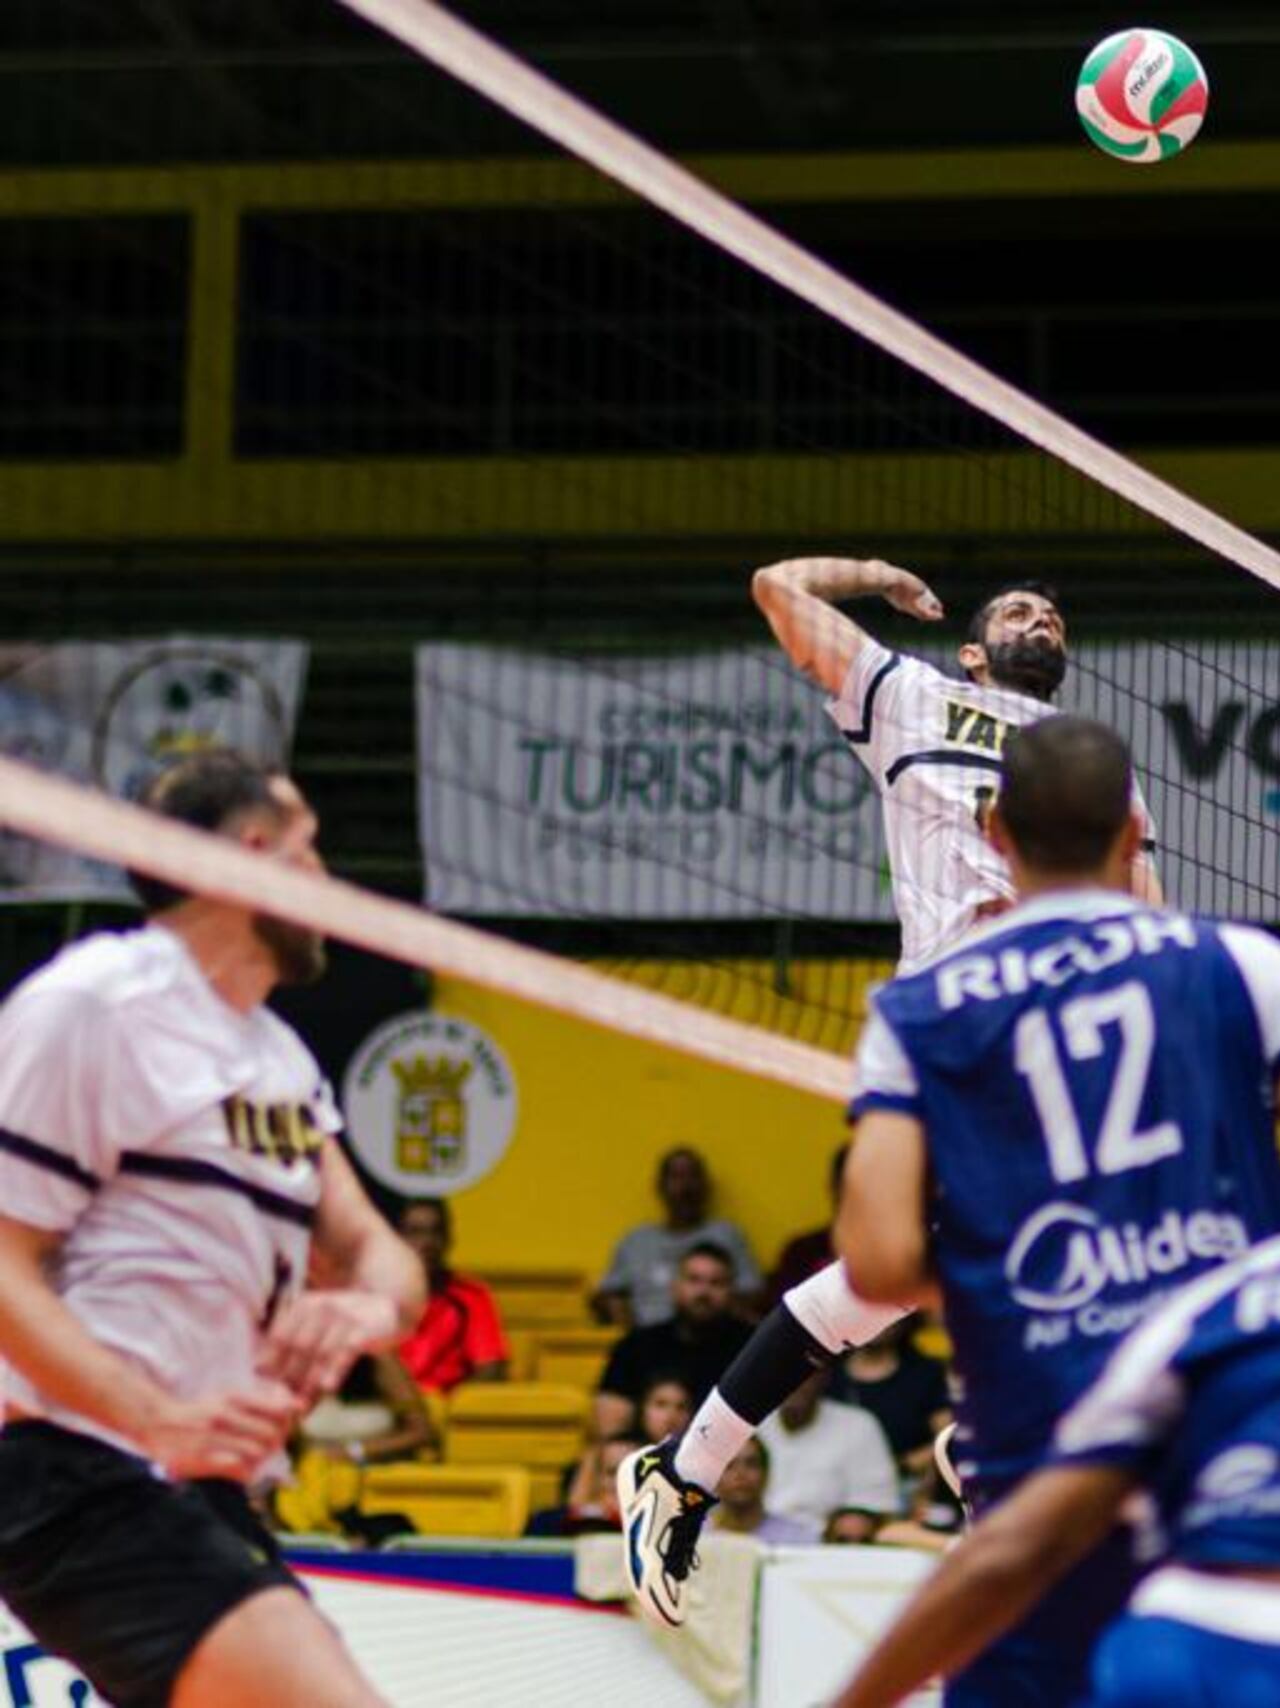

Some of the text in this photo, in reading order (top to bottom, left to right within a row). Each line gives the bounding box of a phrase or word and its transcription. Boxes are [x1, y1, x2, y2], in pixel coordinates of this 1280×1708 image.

[944, 700, 1018, 752] YA
[518, 736, 872, 816] TURISMO
[934, 914, 1198, 1011] RICOH
[1013, 980, 1185, 1185] 12
